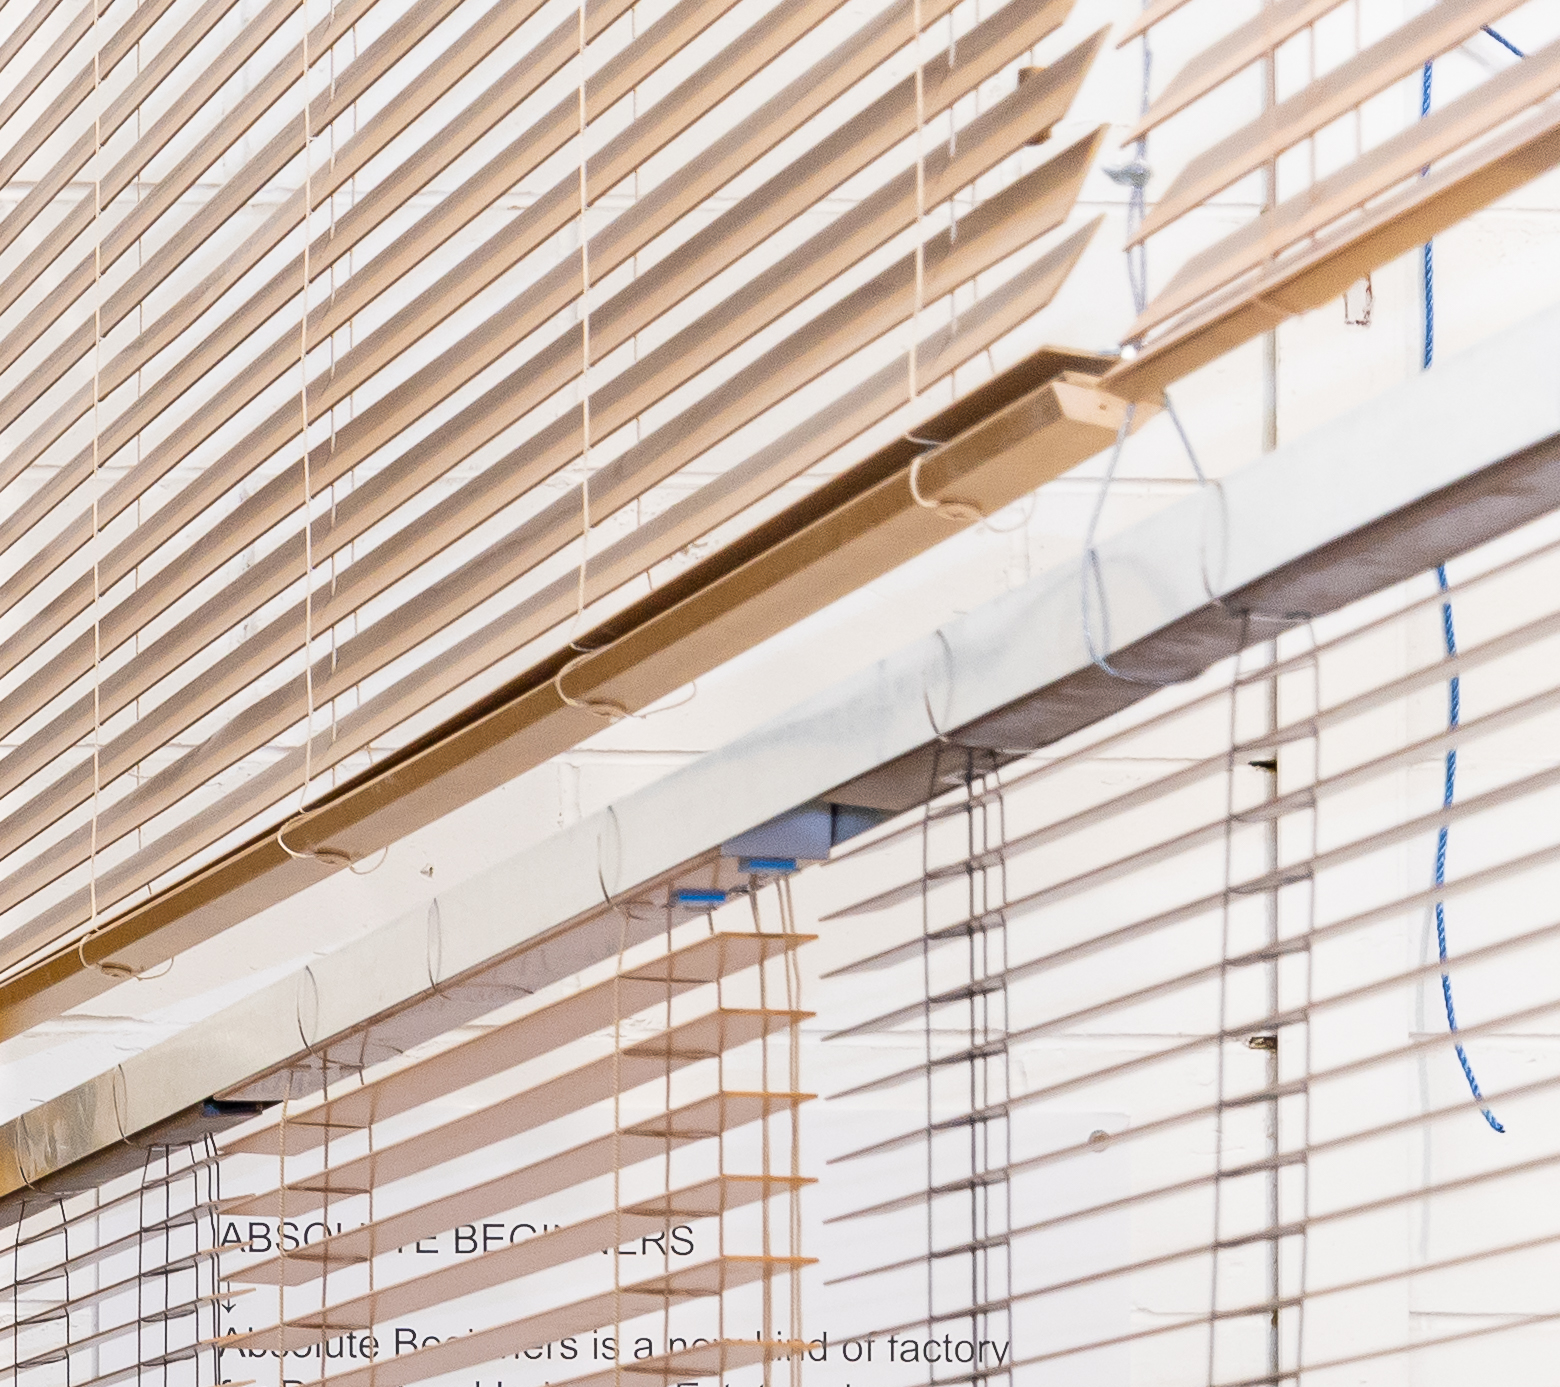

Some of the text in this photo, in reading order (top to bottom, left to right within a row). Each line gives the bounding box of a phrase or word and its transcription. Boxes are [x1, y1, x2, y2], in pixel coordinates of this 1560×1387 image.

[221, 1222, 439, 1253] ABSOE
[594, 1330, 619, 1359] is
[634, 1337, 653, 1360] a
[843, 1336, 873, 1362] of
[887, 1333, 1010, 1366] factory
